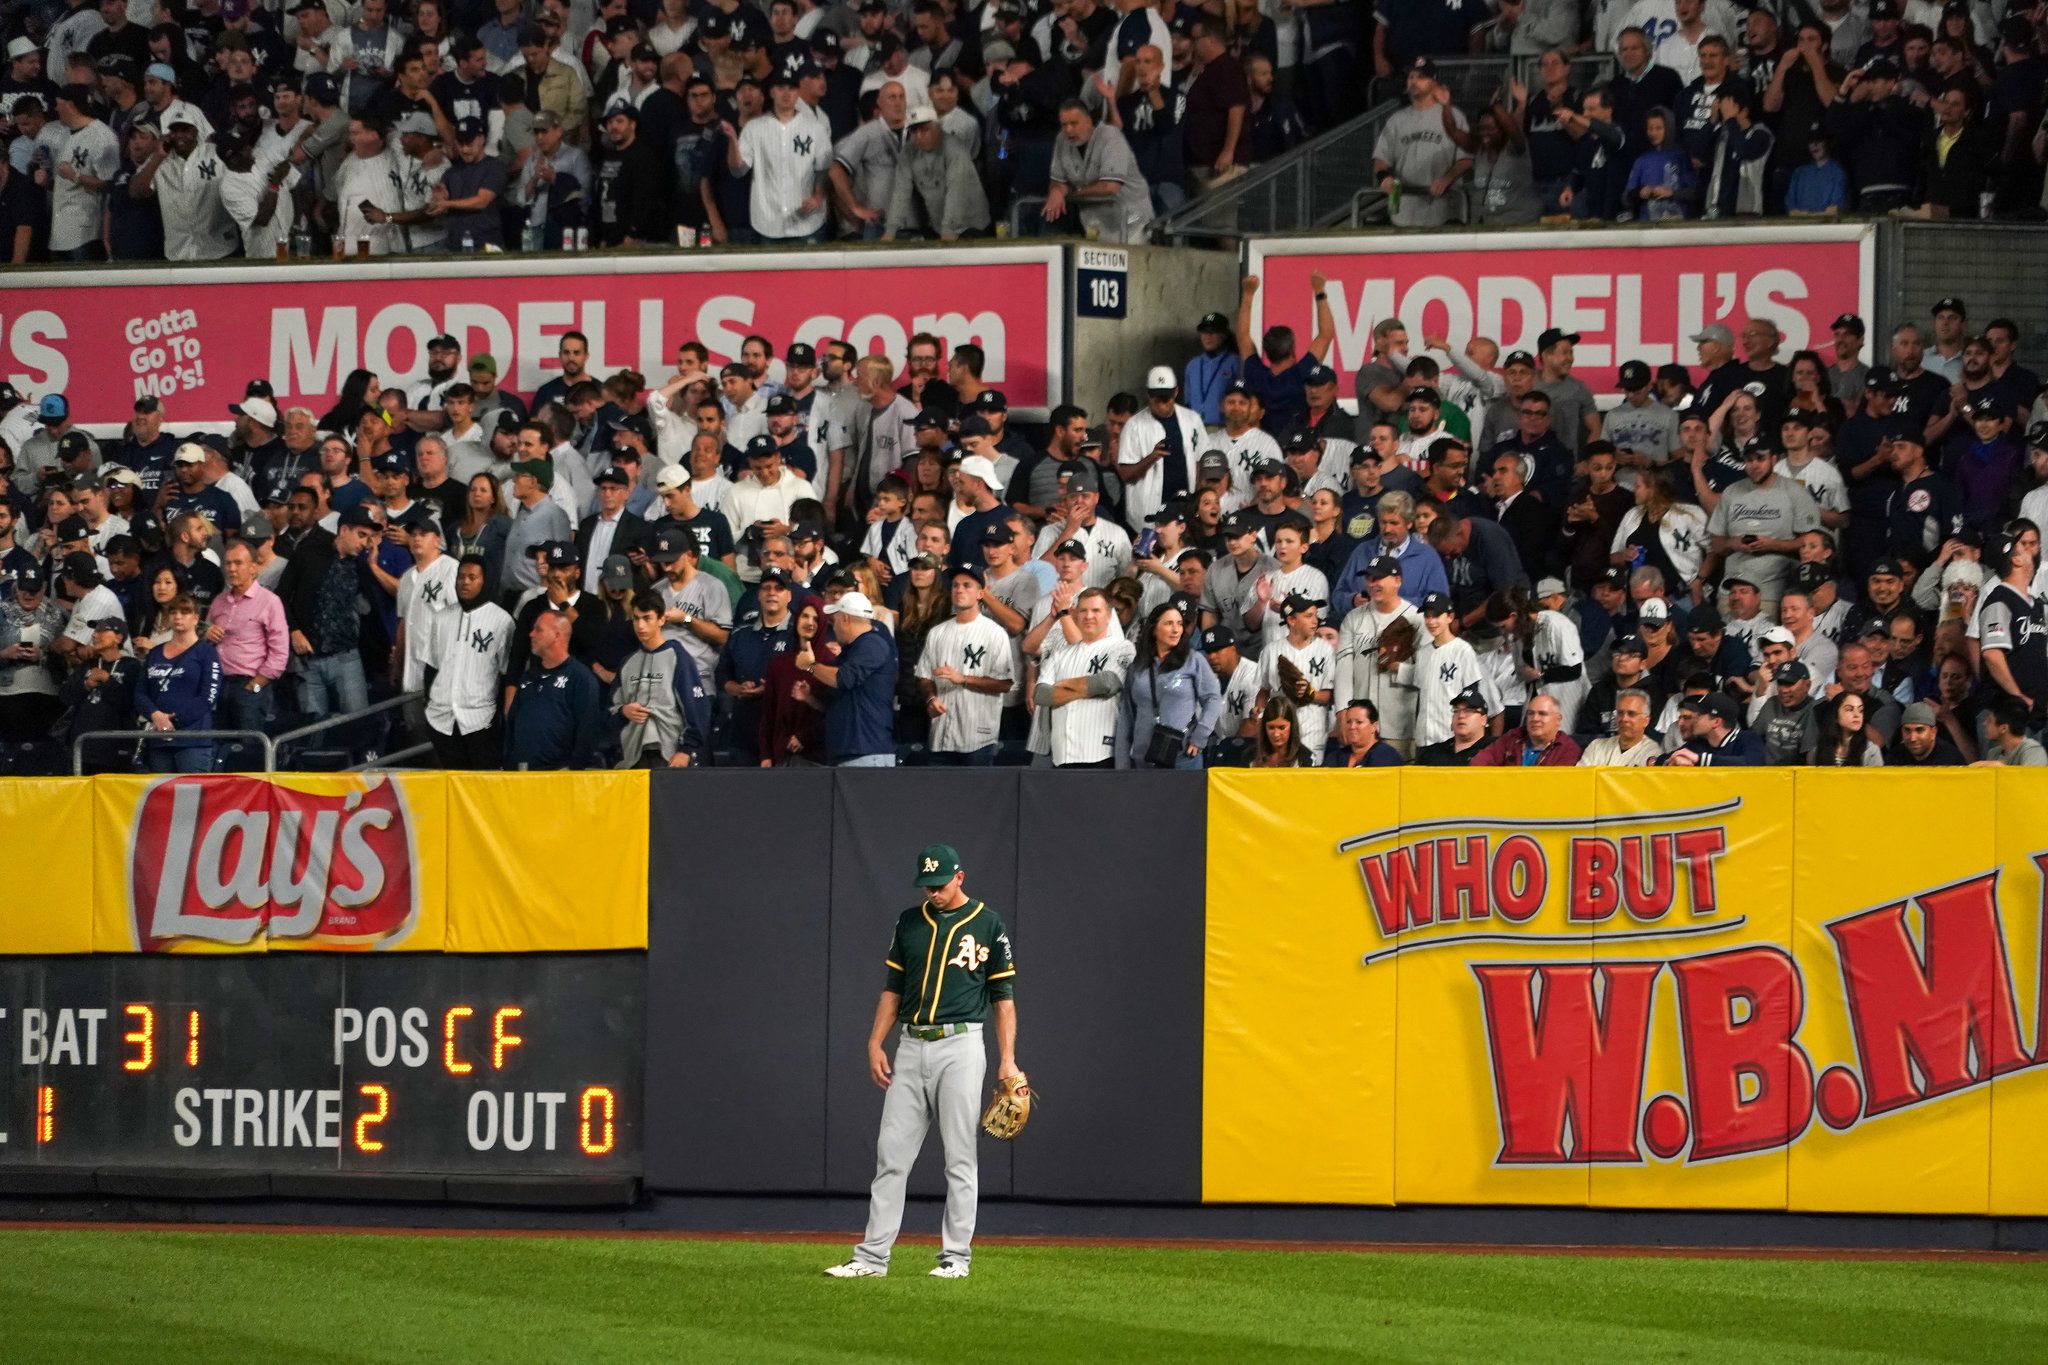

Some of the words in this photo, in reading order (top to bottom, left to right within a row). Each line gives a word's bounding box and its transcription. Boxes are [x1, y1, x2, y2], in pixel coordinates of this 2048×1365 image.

[793, 133, 814, 157] NY
[198, 158, 217, 181] NY
[1084, 251, 1126, 267] SECTION
[1090, 278, 1119, 308] 103
[125, 308, 198, 344] Gotta
[130, 346, 166, 373] Go
[166, 335, 200, 362] To
[134, 359, 205, 401] Mo's!
[1731, 504, 1780, 521] Yankees
[421, 579, 443, 604] NY
[471, 628, 494, 654] NY
[963, 643, 987, 670] NY
[1309, 656, 1326, 678] NY
[1440, 662, 1458, 682] NY
[150, 784, 393, 944] Lay's
[1358, 832, 1550, 938] WHO
[1567, 824, 1727, 925] BUT
[328, 916, 357, 925] BRAND
[948, 934, 990, 972] A's
[21, 1008, 107, 1065] BAT
[333, 1007, 430, 1066] POS
[174, 1088, 341, 1148] STRIKE
[353, 1084, 389, 1152] 2
[466, 1090, 567, 1151] OUT
[580, 1086, 614, 1154] 0
